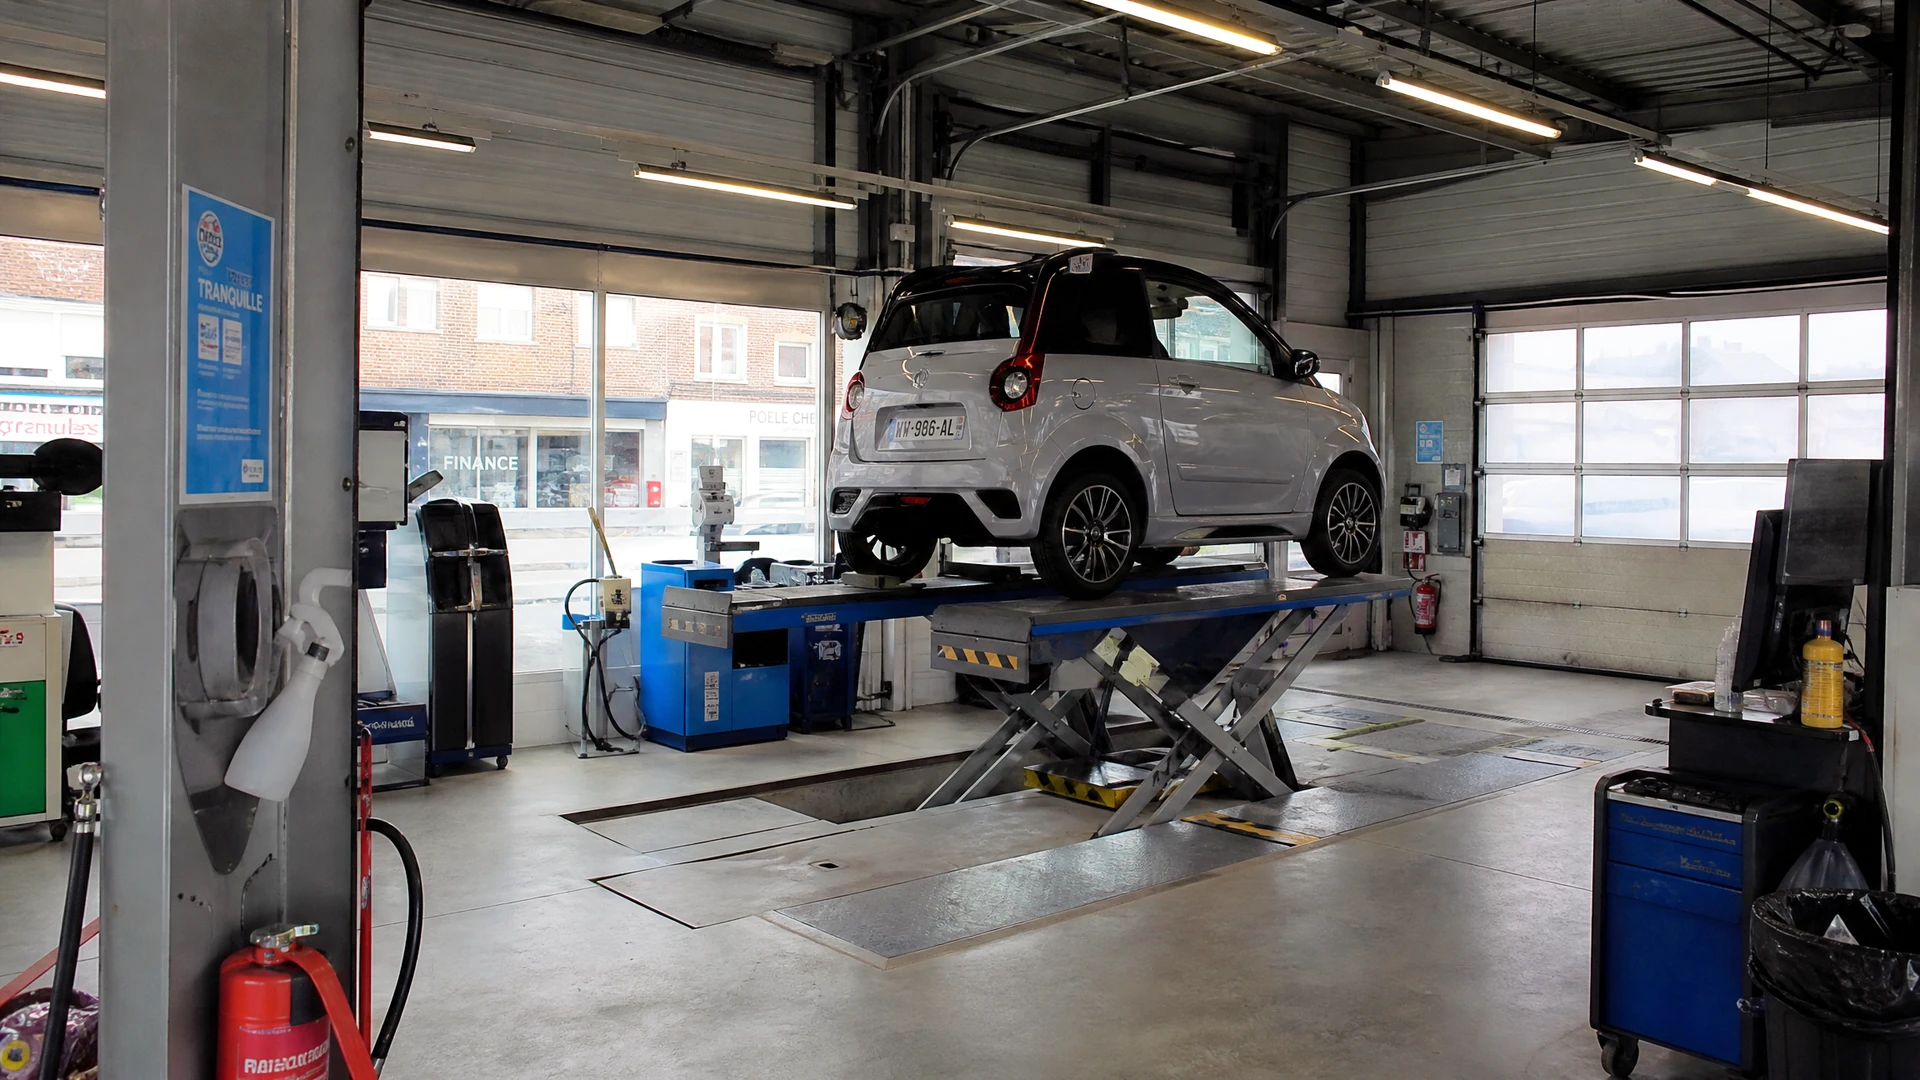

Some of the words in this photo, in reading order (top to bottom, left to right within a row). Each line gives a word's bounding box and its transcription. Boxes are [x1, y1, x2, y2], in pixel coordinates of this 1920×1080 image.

[197, 277, 264, 313] TRANQUILLE
[749, 410, 789, 424] POELE
[443, 455, 519, 471] FINANCE
